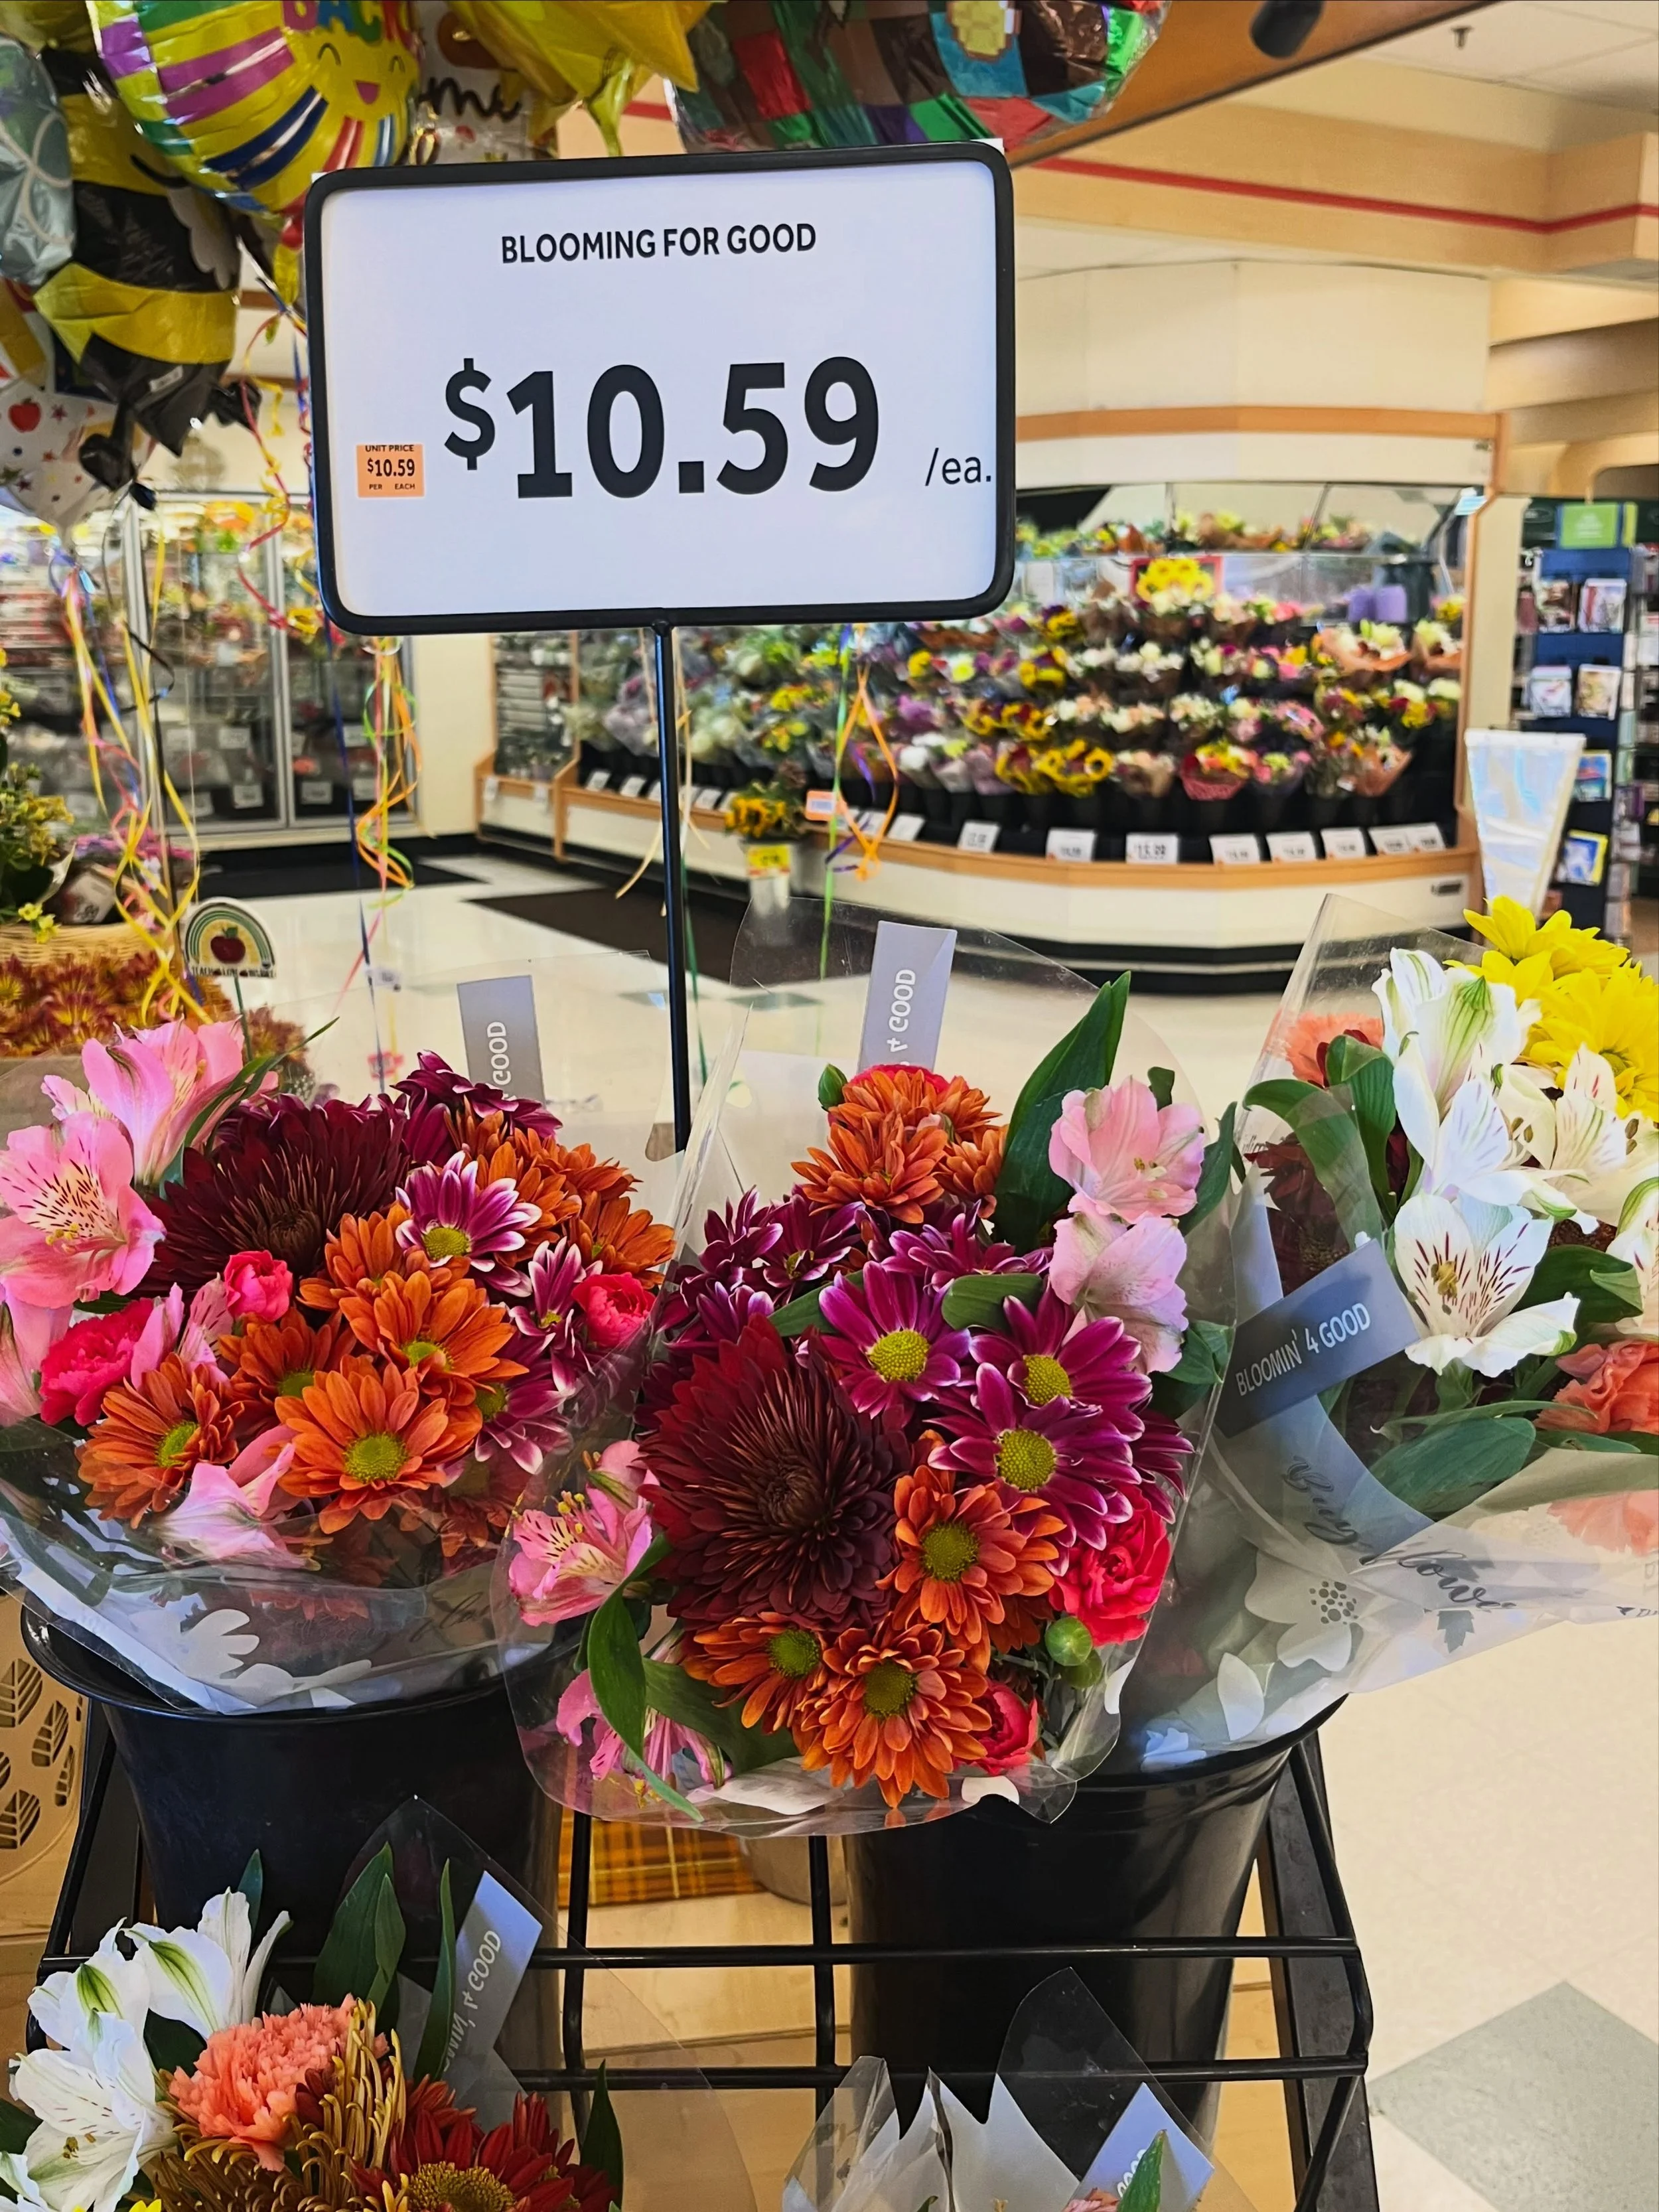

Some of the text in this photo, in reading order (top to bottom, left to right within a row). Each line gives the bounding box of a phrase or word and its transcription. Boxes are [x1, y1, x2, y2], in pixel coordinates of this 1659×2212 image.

[502, 223, 816, 264] BLOOMING FOR GOOD
[444, 356, 992, 499] $10.59 /ea.
[365, 444, 387, 453] UNIT
[367, 457, 415, 477] $10.59
[1235, 1302, 1370, 1396] BLOOMIN' 4 GOOD
